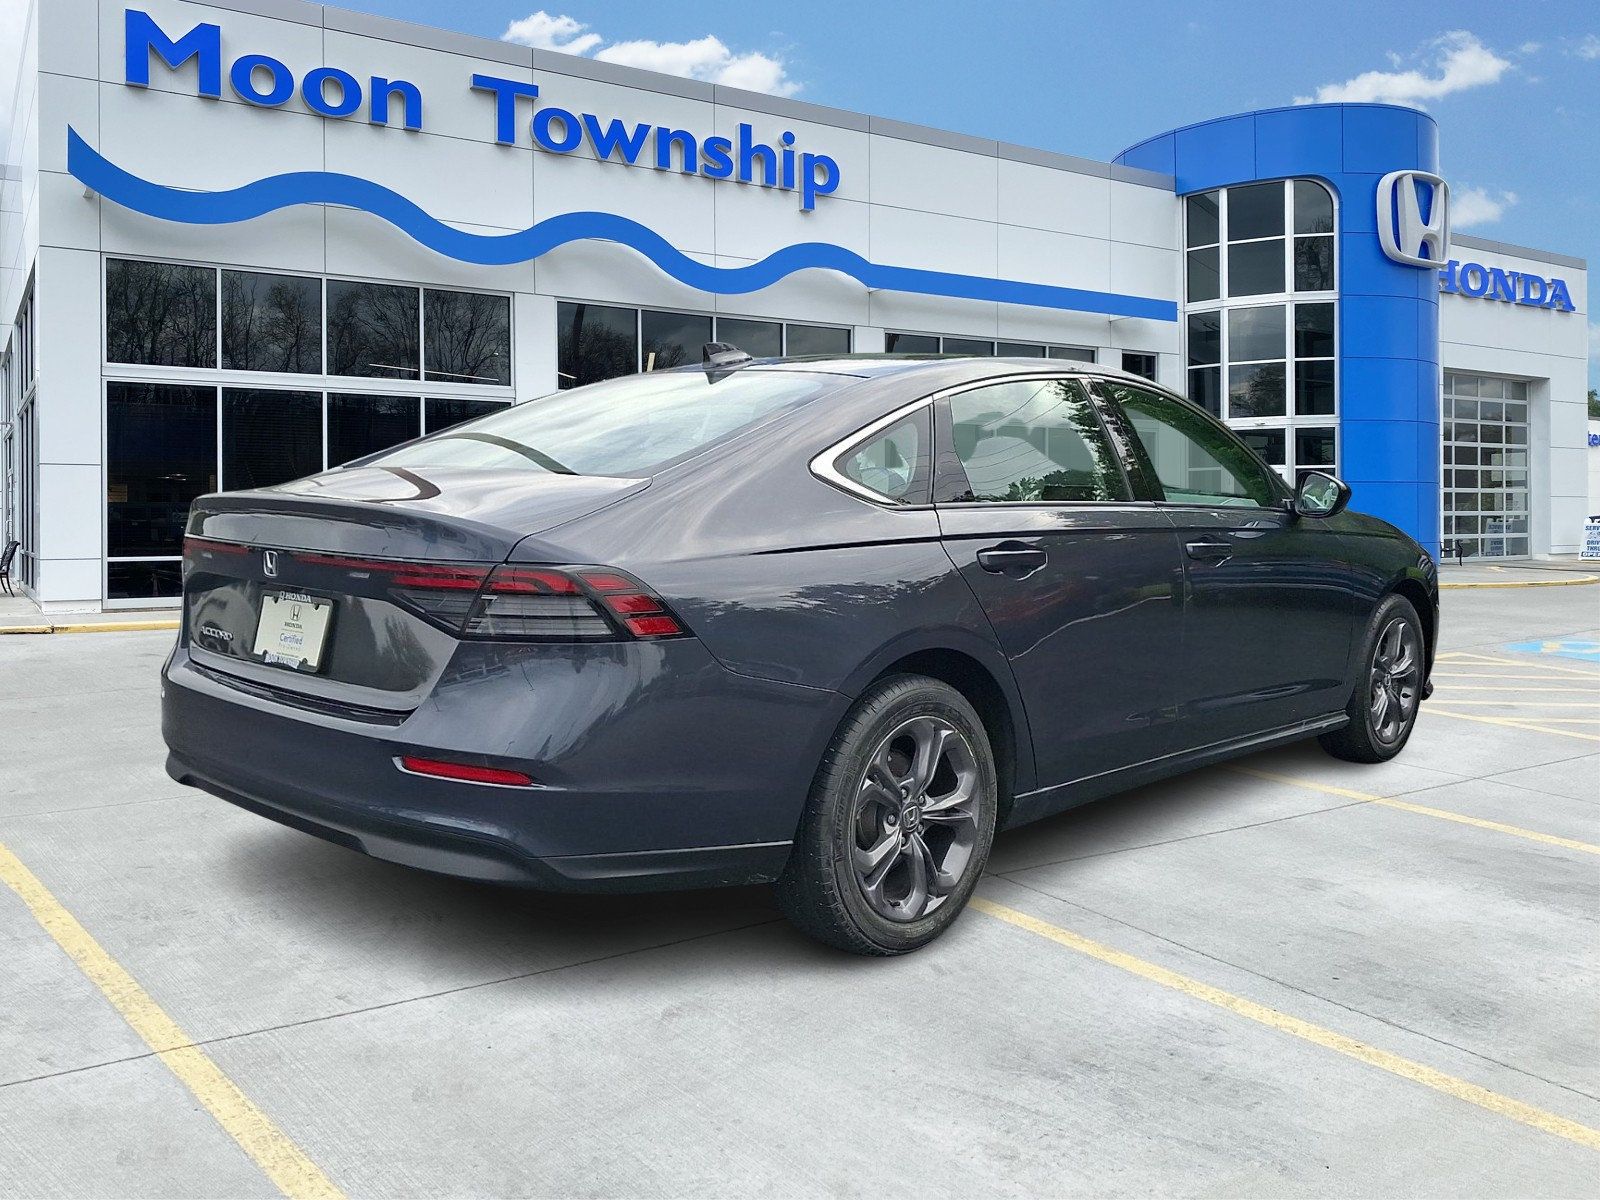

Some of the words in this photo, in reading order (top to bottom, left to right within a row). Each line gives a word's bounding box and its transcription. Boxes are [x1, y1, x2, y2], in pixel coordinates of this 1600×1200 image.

[125, 9, 423, 132] Moon
[470, 73, 841, 213] Township
[285, 591, 312, 603] HONDA
[200, 625, 233, 641] ACCORD
[279, 632, 304, 646] Certified
